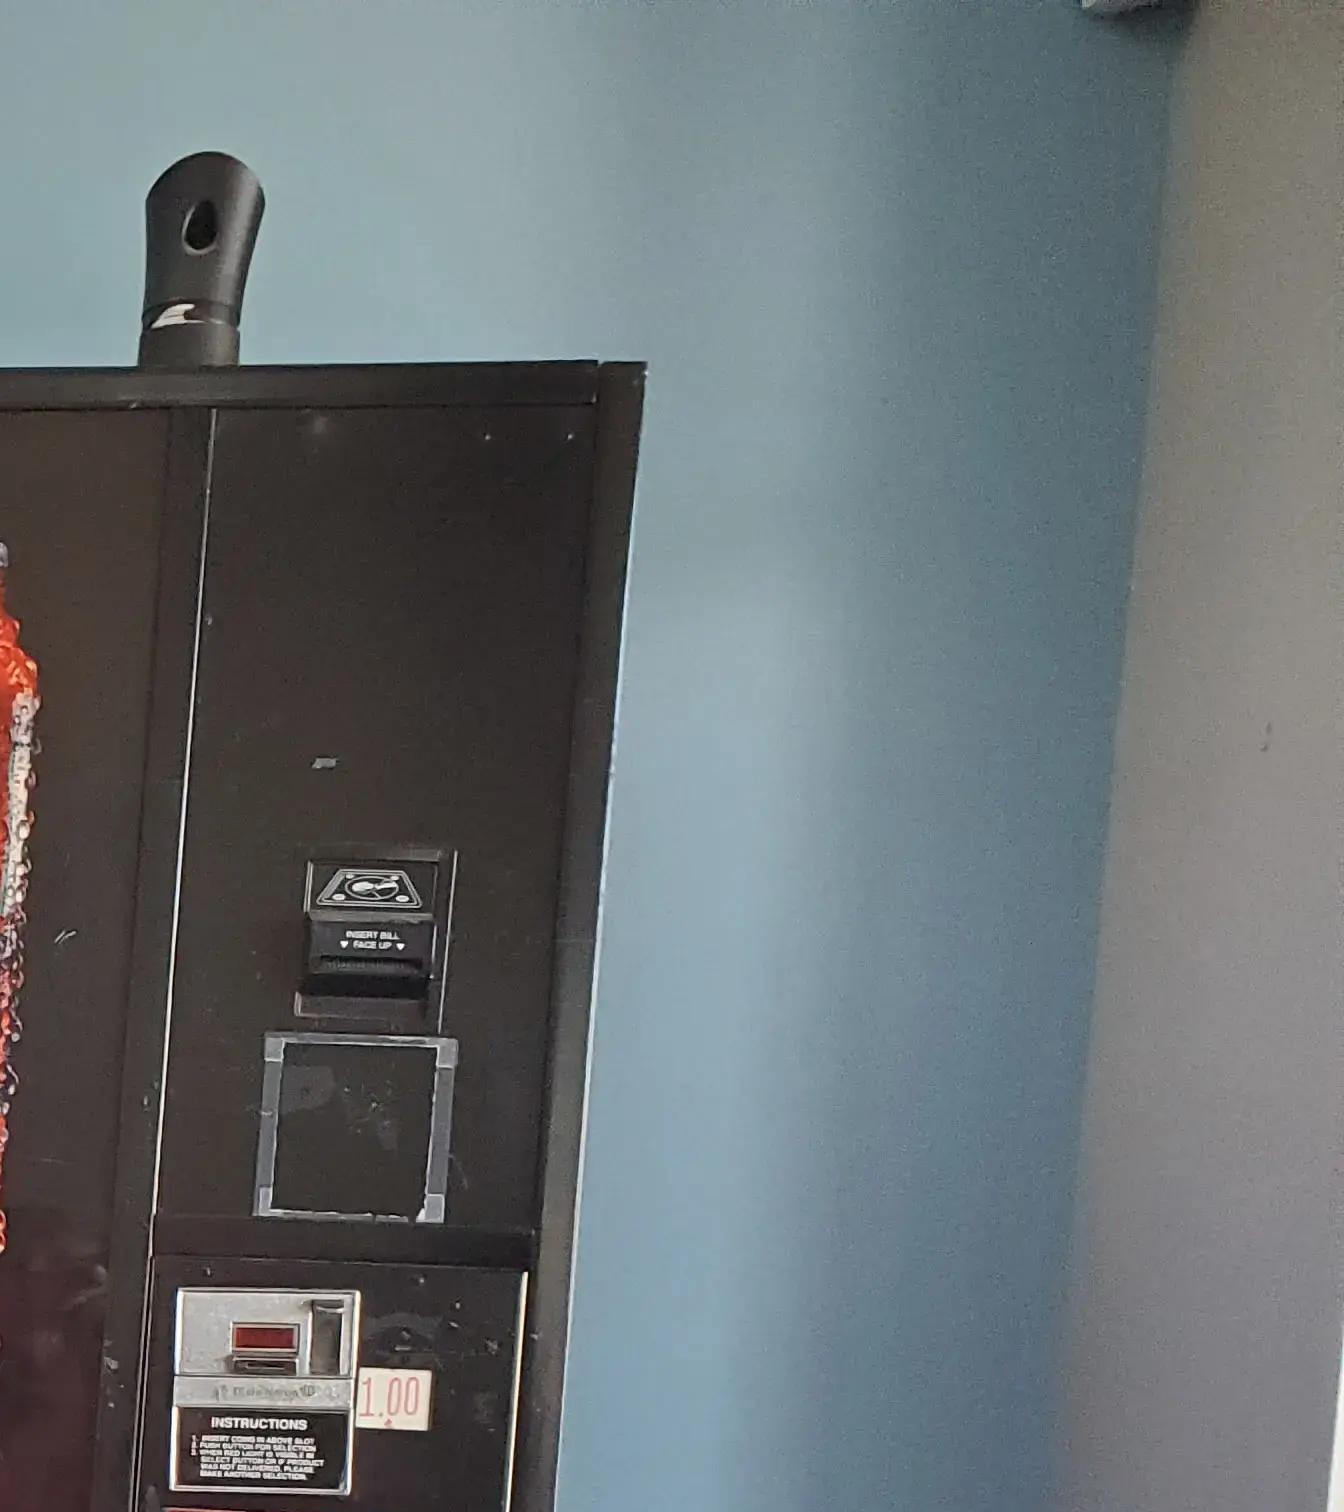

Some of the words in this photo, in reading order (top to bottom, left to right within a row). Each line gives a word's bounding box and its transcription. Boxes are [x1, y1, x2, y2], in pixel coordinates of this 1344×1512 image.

[379, 941, 392, 950] UP
[359, 1376, 419, 1418] 1.00
[211, 1416, 308, 1430] INSTRUCTIONS
